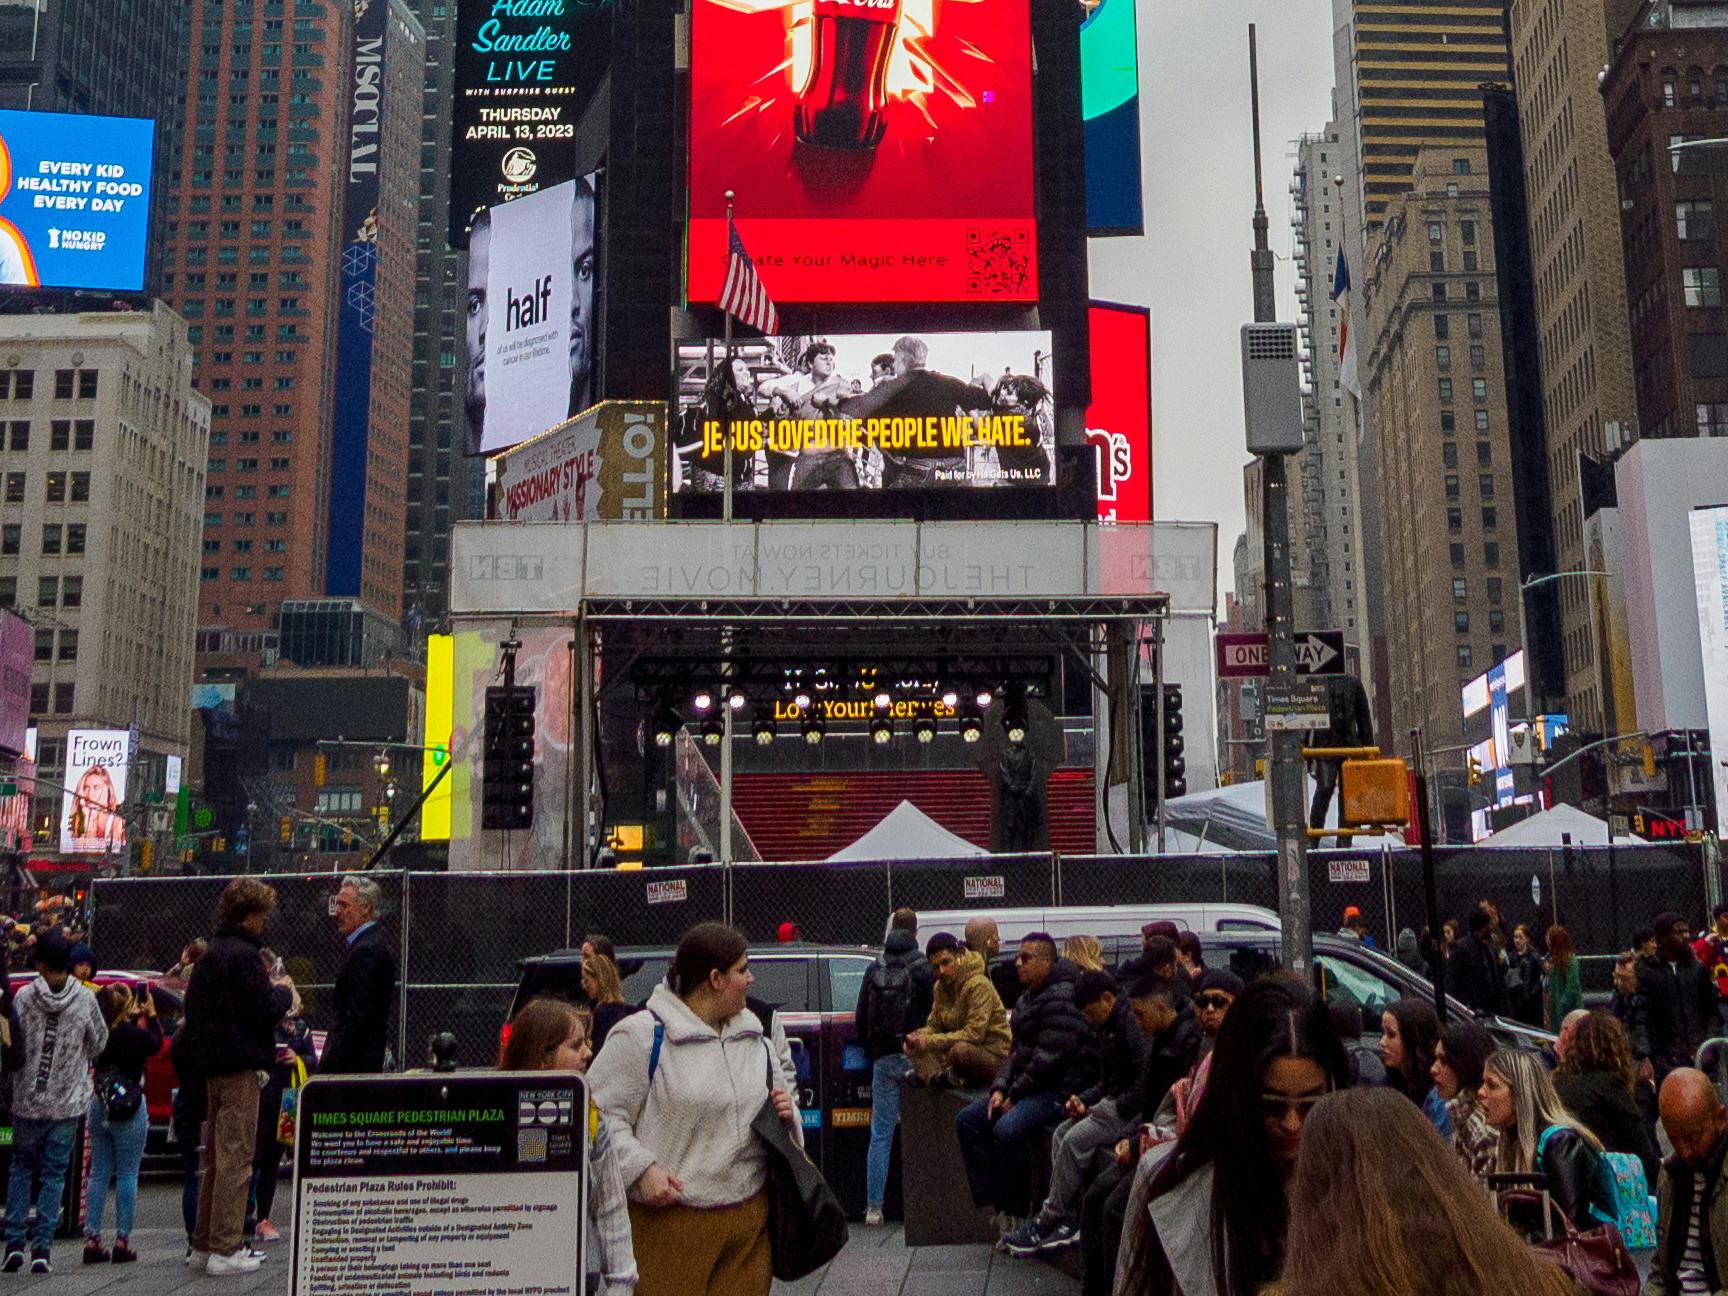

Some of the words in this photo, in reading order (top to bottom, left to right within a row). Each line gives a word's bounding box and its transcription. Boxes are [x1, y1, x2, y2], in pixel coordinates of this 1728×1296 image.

[472, 19, 572, 53] Sandler
[486, 60, 556, 81] LIVE
[479, 107, 562, 122] THURSDAY
[465, 125, 511, 140] APRIL
[513, 125, 534, 141] 13,
[536, 124, 574, 138] 2023
[38, 160, 93, 177] EVERY
[95, 163, 125, 179] KID
[17, 175, 92, 194] HEALTHY
[95, 180, 143, 197] FOOD
[33, 194, 89, 211] EVERY
[91, 197, 125, 213] DAY
[791, 252, 834, 268] Your
[840, 251, 896, 272] Magic
[903, 252, 947, 267] Here
[506, 274, 552, 333] half
[701, 420, 763, 458] JESUS
[867, 417, 937, 449] PEOPLE
[941, 416, 975, 448] WE
[977, 415, 1032, 447] HATE.
[505, 463, 562, 512] MISSIONARY
[562, 448, 594, 490] STYLE
[934, 469, 952, 481] Paid
[1024, 468, 1042, 480] LLC
[1235, 645, 1269, 664] ONE
[1294, 644, 1324, 664] WAY
[1266, 694, 1290, 704] Times
[1290, 694, 1319, 704] Square
[73, 735, 122, 751] Frown
[71, 751, 124, 768] Lines?
[1329, 862, 1370, 874] NATIONAL
[964, 877, 1004, 888] NATIONAL
[311, 1112, 348, 1126] TIMES
[349, 1111, 395, 1125] SQUARE
[397, 1110, 461, 1124] PEDESTRIAN
[463, 1108, 505, 1122] PLAZA
[518, 1101, 573, 1124] DOT
[306, 1180, 358, 1194] Pedestrian
[360, 1180, 386, 1193] Plaza
[387, 1180, 414, 1192] Rules
[415, 1179, 457, 1192] Prohibit:
